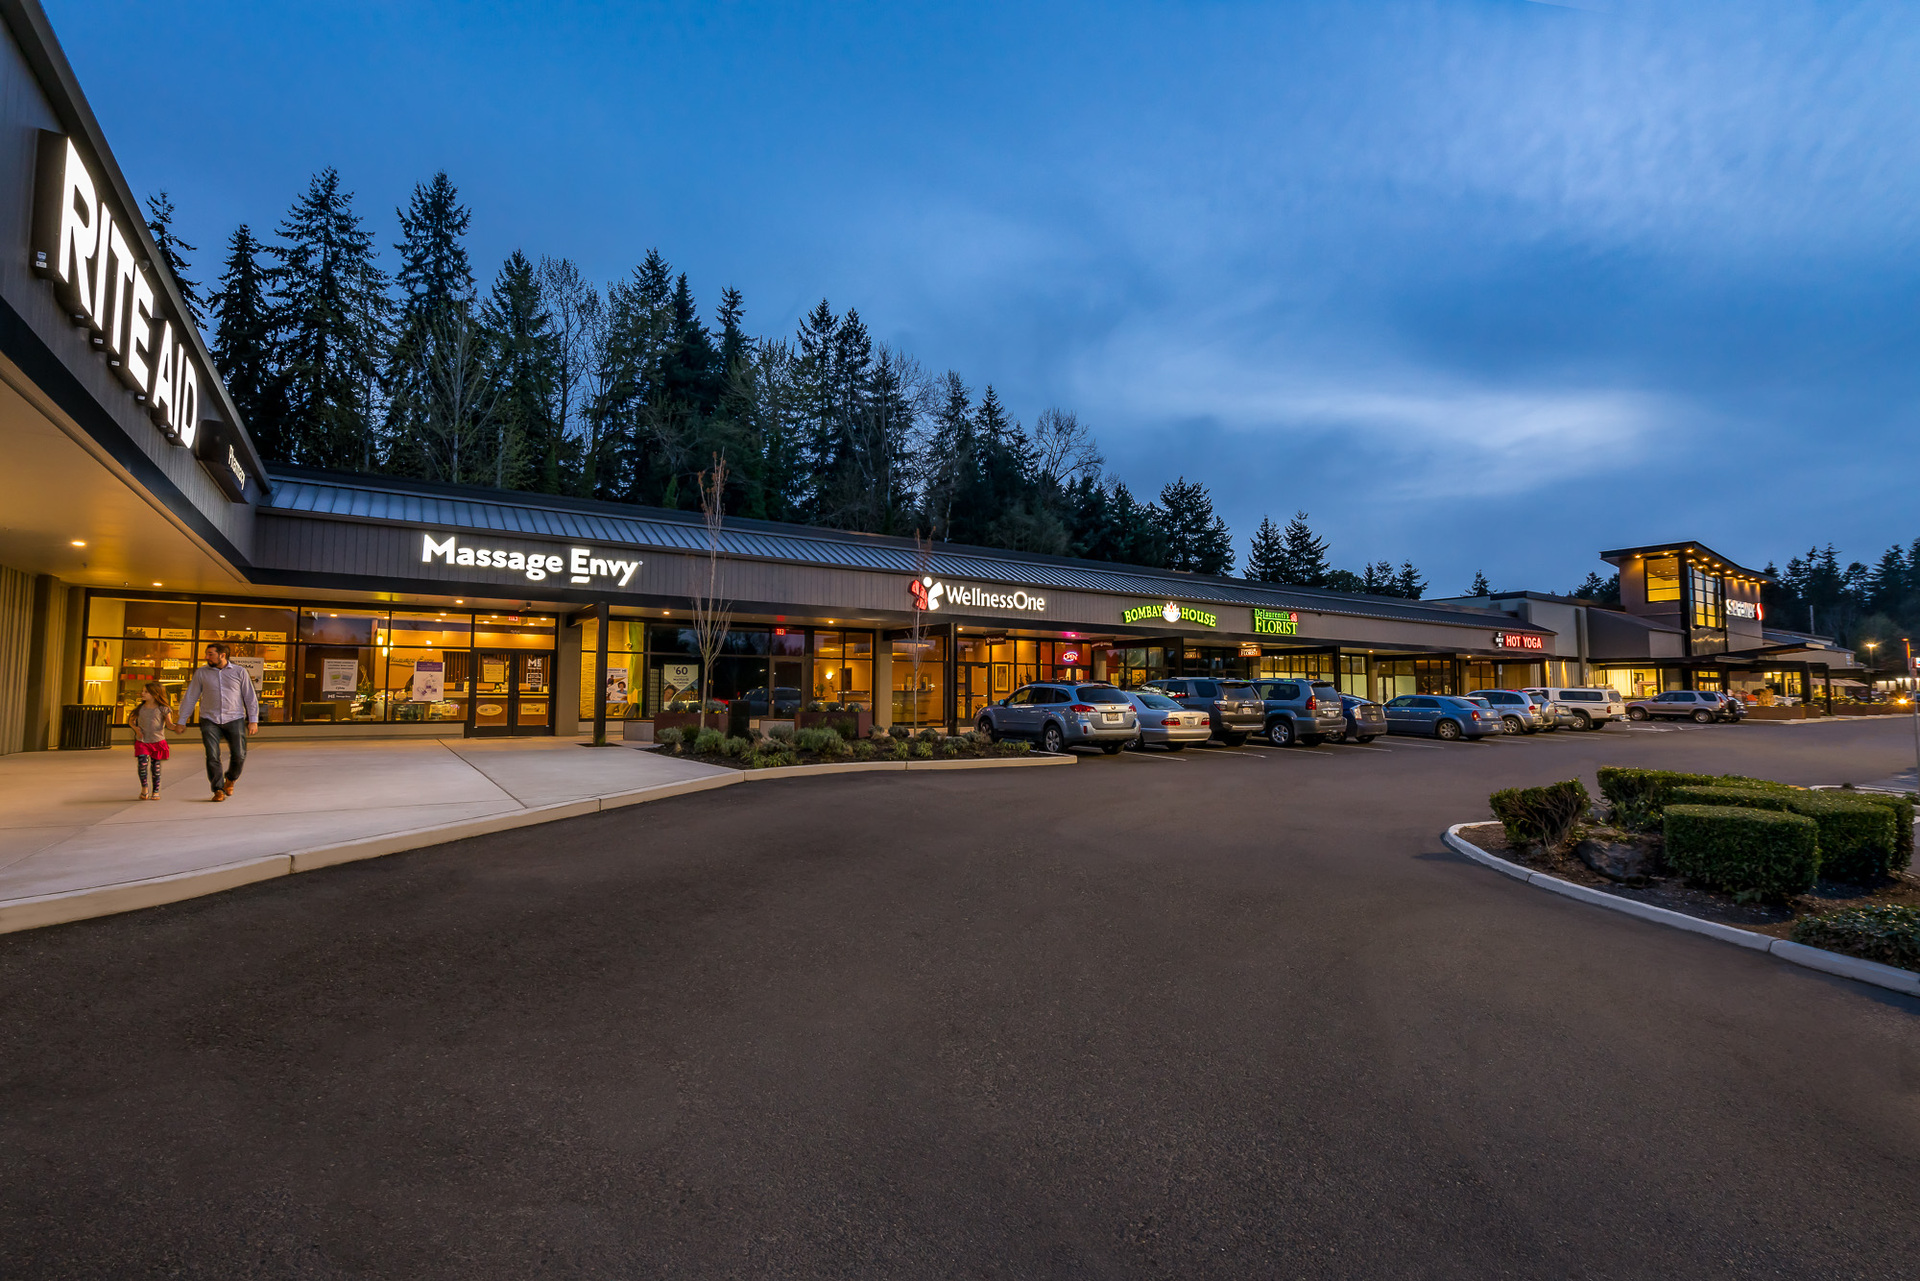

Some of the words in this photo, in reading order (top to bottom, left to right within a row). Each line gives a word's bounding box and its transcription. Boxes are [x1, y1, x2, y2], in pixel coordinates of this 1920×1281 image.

[58, 136, 154, 394] RITE
[152, 320, 198, 449] AID
[228, 444, 246, 490] Pharmacy
[422, 534, 564, 581] Massage
[571, 548, 639, 587] Envy
[945, 585, 1045, 611] WellnessOne
[1124, 605, 1163, 623] BOMBAY
[1181, 607, 1216, 627] HOUSE
[1254, 616, 1298, 635] FLORIST
[1506, 635, 1521, 647] HOT
[1523, 637, 1543, 649] YOGA
[1063, 653, 1078, 661] OPEN
